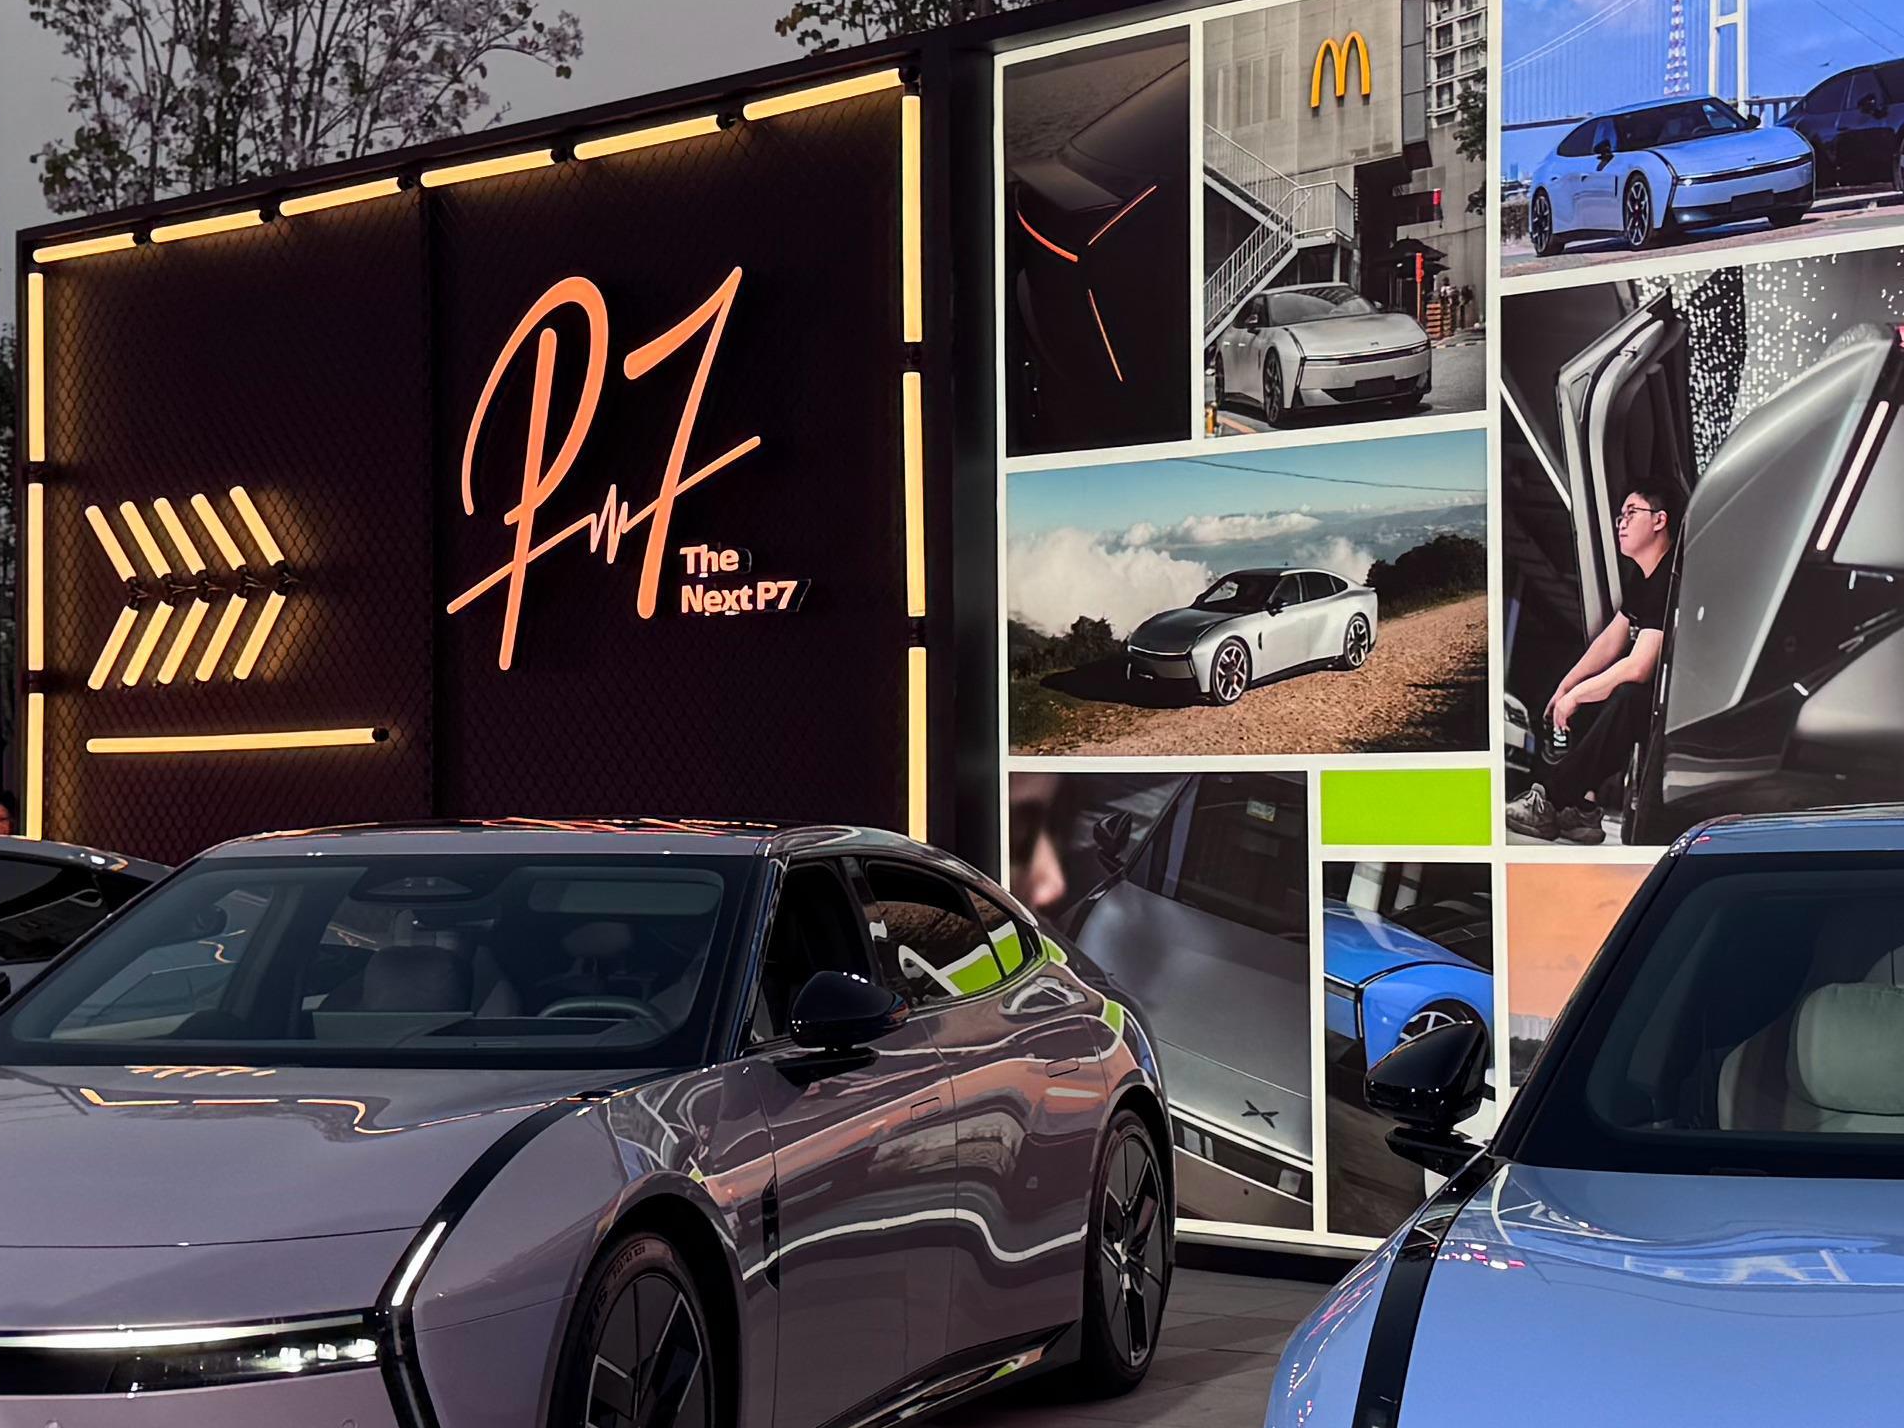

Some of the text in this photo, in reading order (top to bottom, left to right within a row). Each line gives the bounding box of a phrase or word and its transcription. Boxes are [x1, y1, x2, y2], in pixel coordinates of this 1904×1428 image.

[679, 544, 740, 575] The
[681, 580, 798, 615] Next P7
